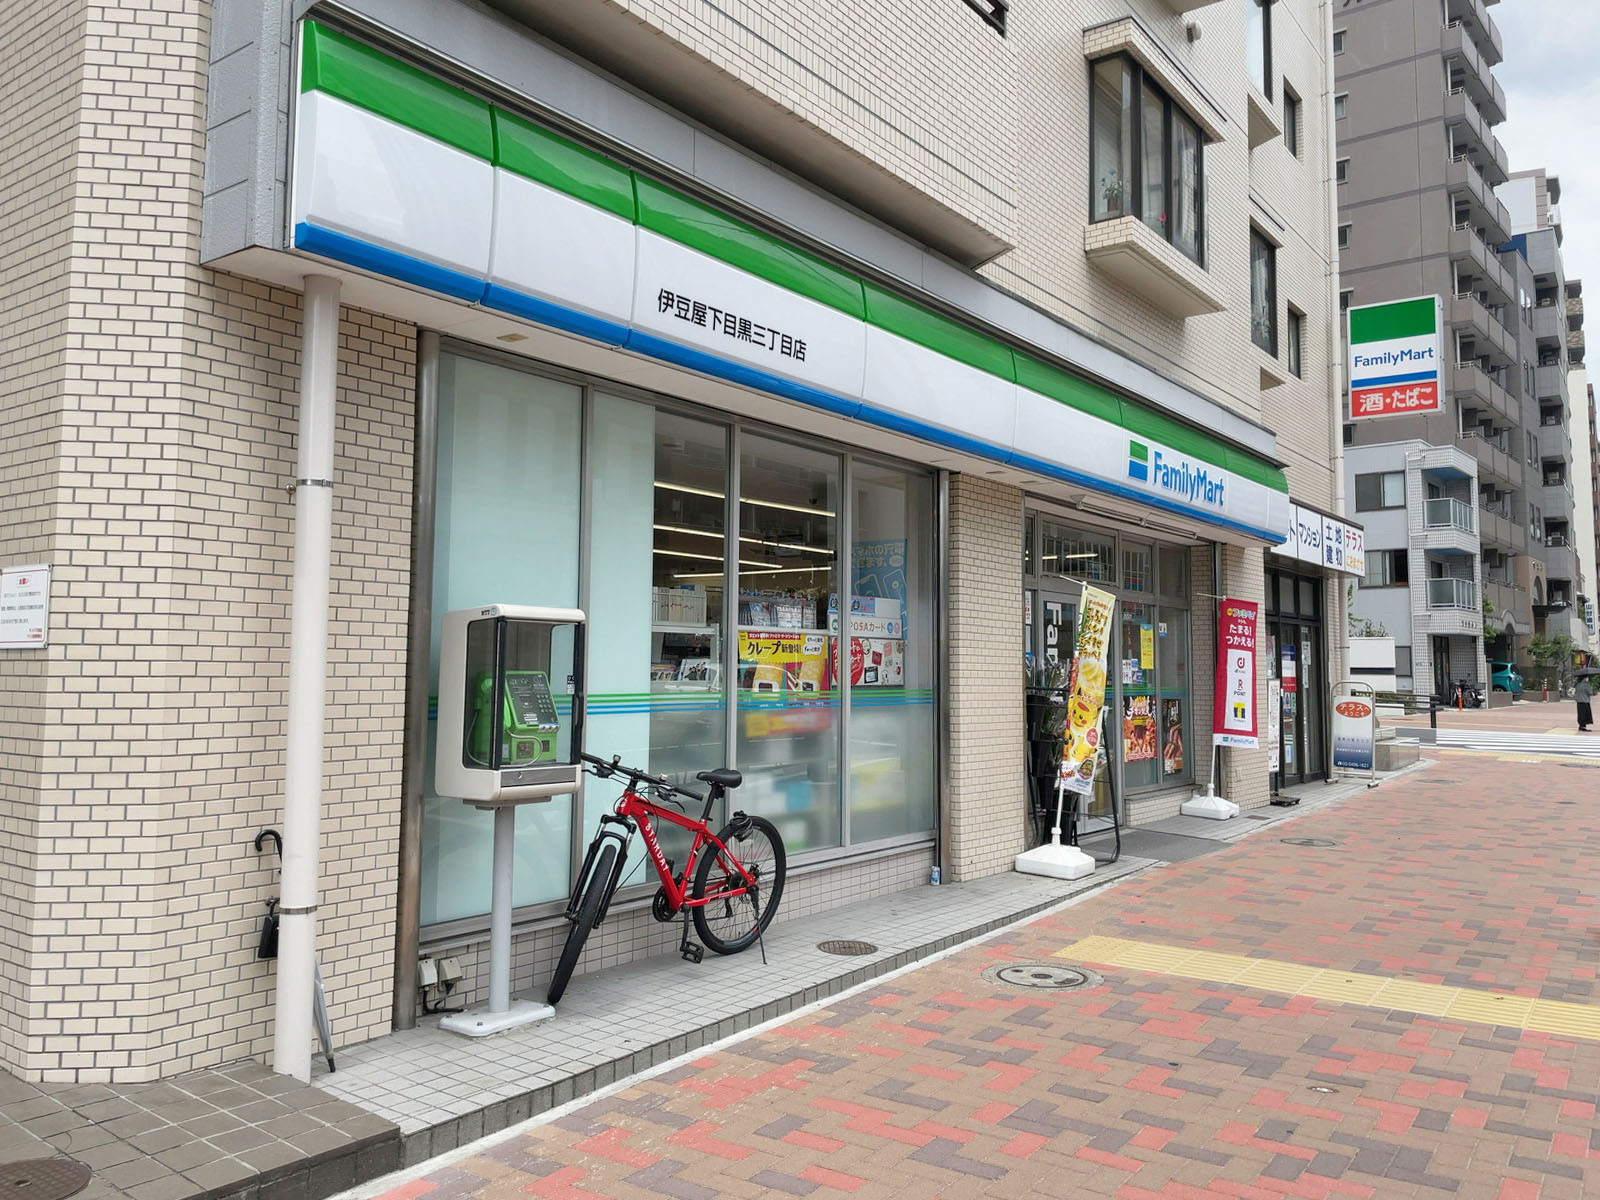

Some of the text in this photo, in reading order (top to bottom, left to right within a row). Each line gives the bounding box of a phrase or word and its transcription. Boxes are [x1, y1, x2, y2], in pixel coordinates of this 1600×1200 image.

[657, 288, 807, 362] 伊豆屋下目黒三丁目店
[1354, 347, 1434, 368] FamilyMart
[1360, 387, 1433, 412] 酒・たばこ
[1153, 450, 1224, 507] FamilyMart
[1345, 529, 1363, 553] テラス
[747, 640, 781, 656] クレープ
[1225, 635, 1255, 649] つかえる!
